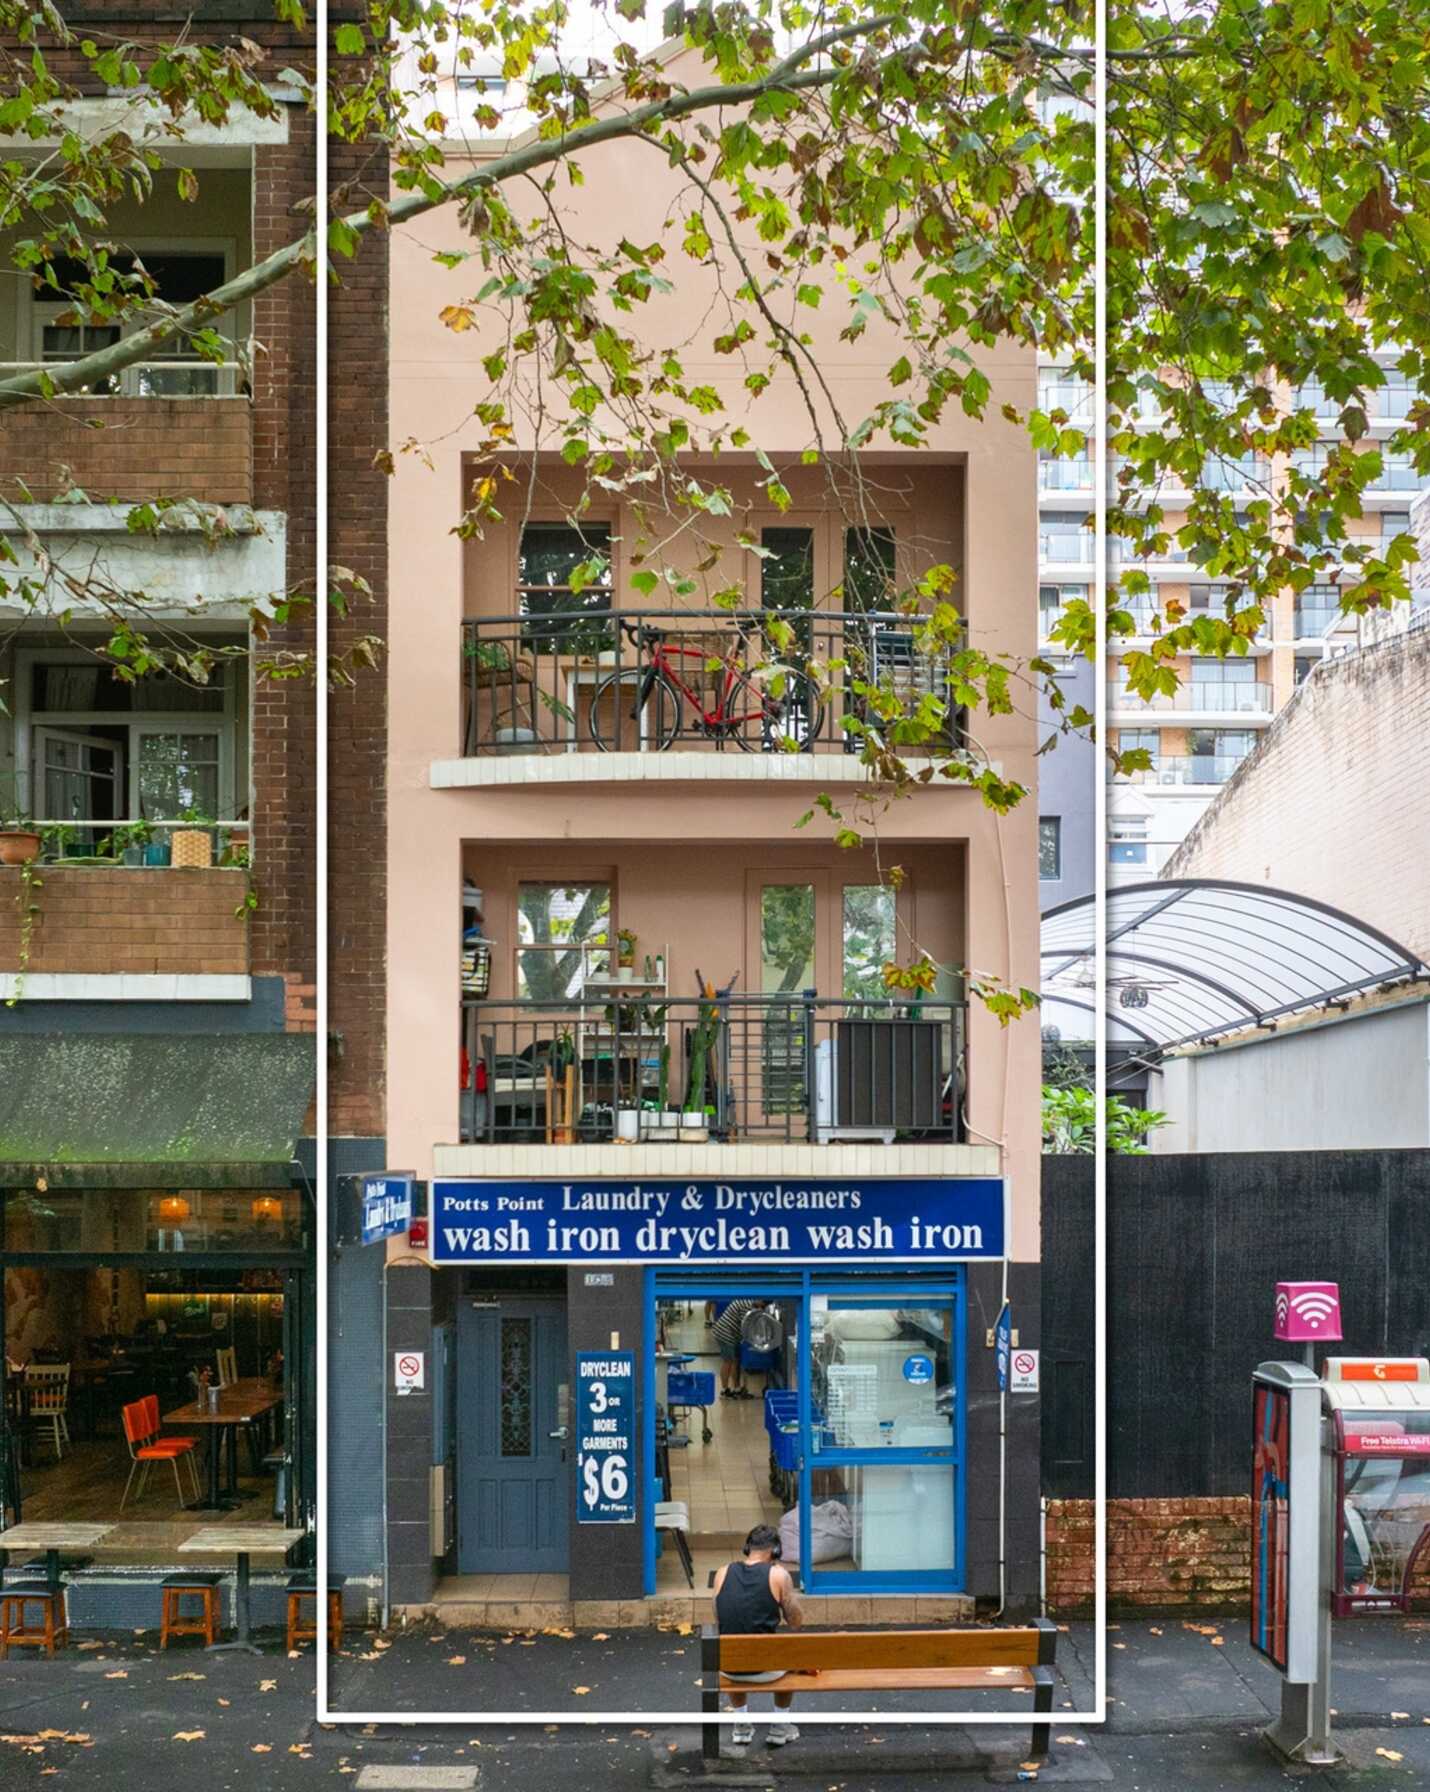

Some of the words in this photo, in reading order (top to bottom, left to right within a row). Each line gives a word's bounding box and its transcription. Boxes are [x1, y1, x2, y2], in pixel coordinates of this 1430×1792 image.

[443, 1196, 490, 1212] Potts
[496, 1196, 545, 1212] Point
[562, 1186, 671, 1217] Laundry
[681, 1185, 705, 1210] &
[715, 1185, 862, 1216] Drycleaners
[443, 1219, 531, 1252] wash
[547, 1218, 621, 1252] iron
[636, 1218, 791, 1260] dryclean
[807, 1216, 895, 1250] wash
[910, 1216, 984, 1249] iron
[580, 1361, 631, 1377] DRYCLEAN
[589, 1382, 607, 1413] 3
[608, 1397, 621, 1406] OR
[593, 1418, 617, 1432] MORE
[583, 1437, 628, 1450] GARMENTS
[583, 1455, 628, 1511] $6
